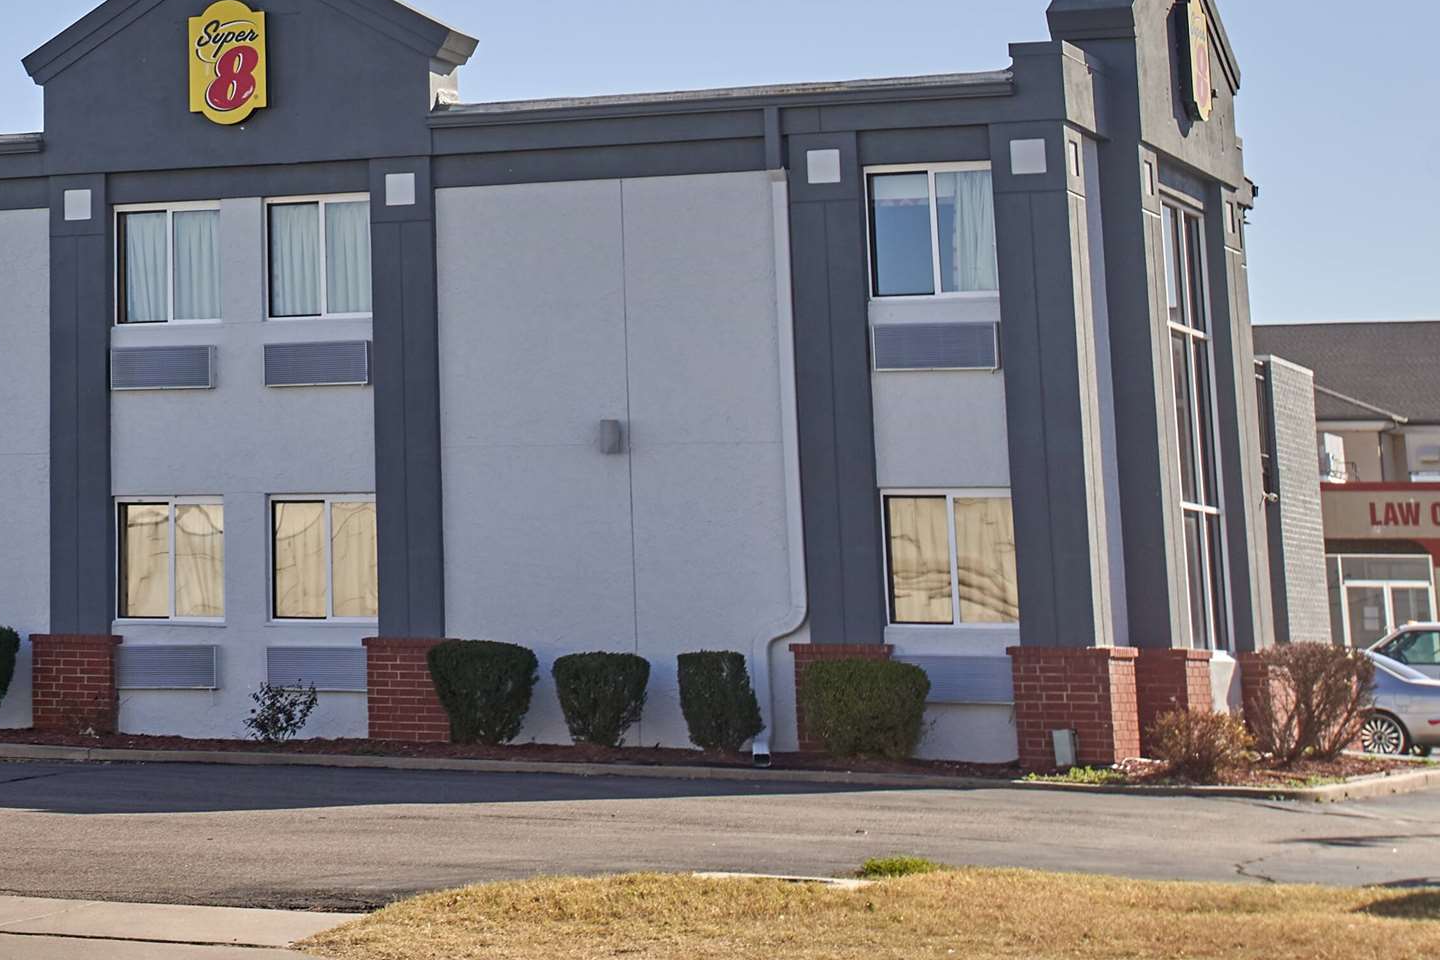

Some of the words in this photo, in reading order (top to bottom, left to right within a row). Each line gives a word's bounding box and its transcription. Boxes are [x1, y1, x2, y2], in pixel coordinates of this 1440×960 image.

[197, 20, 258, 58] Super
[205, 45, 258, 111] 8
[1369, 501, 1420, 526] LAW
